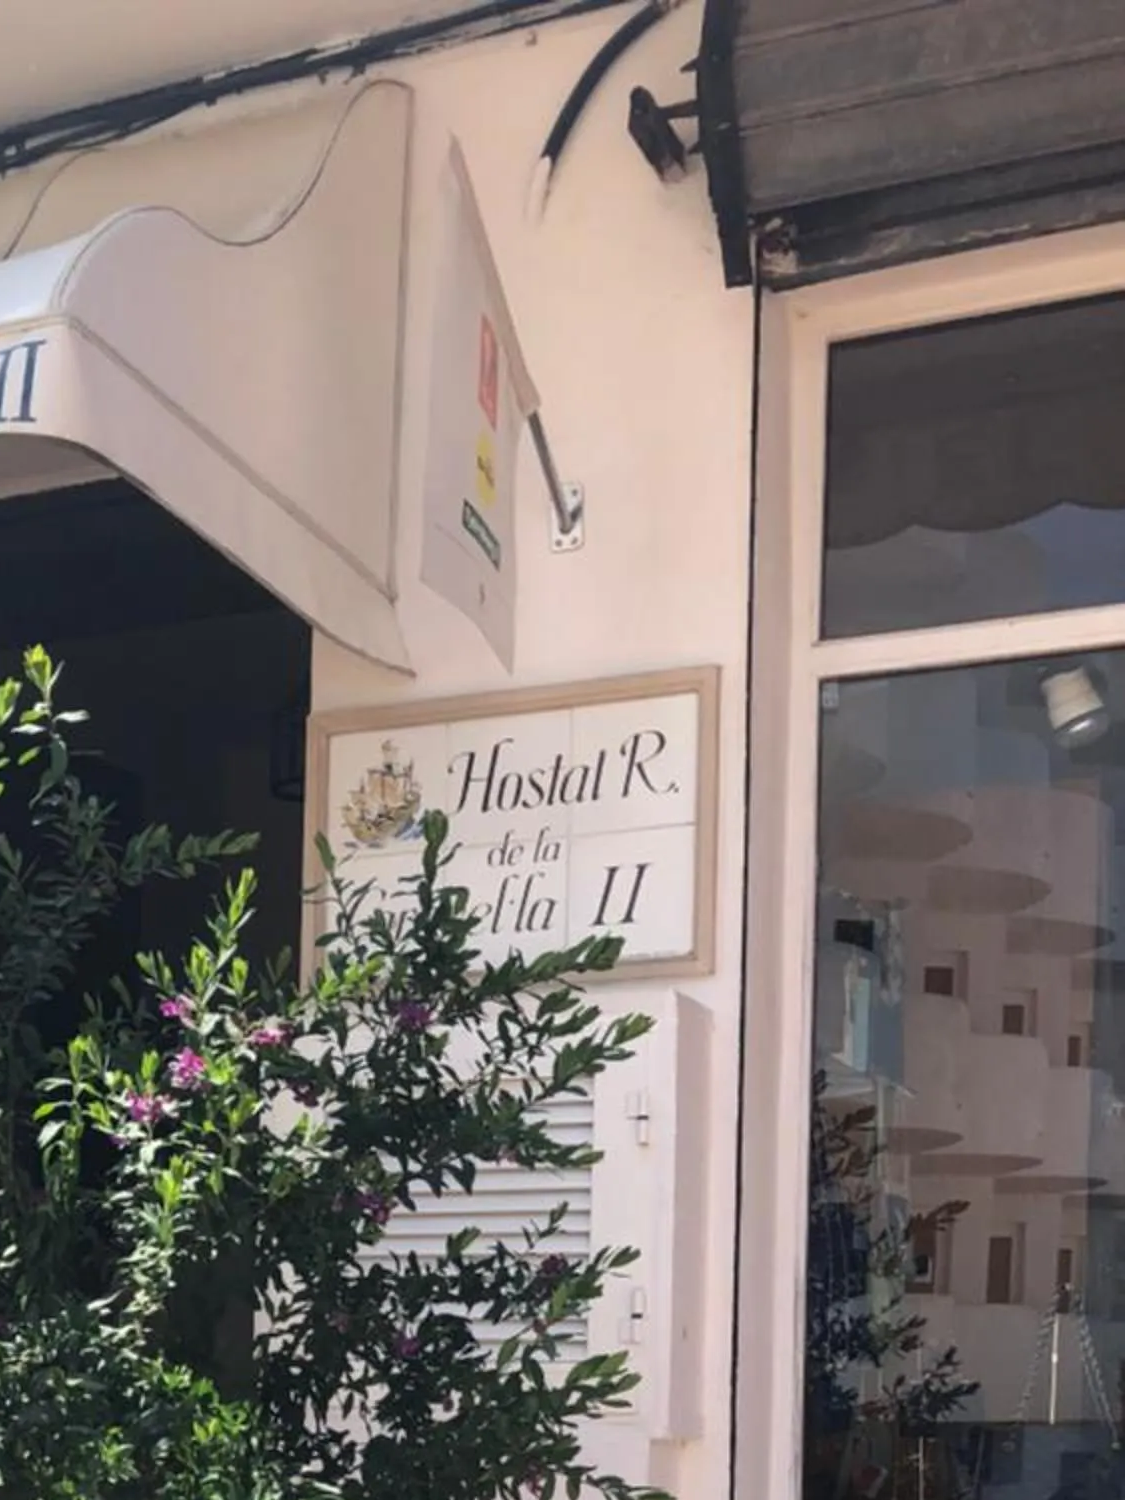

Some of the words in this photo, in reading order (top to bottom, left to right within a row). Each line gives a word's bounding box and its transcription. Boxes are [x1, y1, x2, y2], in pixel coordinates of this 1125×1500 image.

[446, 737, 606, 815] Hostal
[620, 729, 680, 799] R.
[487, 829, 524, 867] de
[533, 826, 561, 864] la
[589, 861, 654, 927] II
